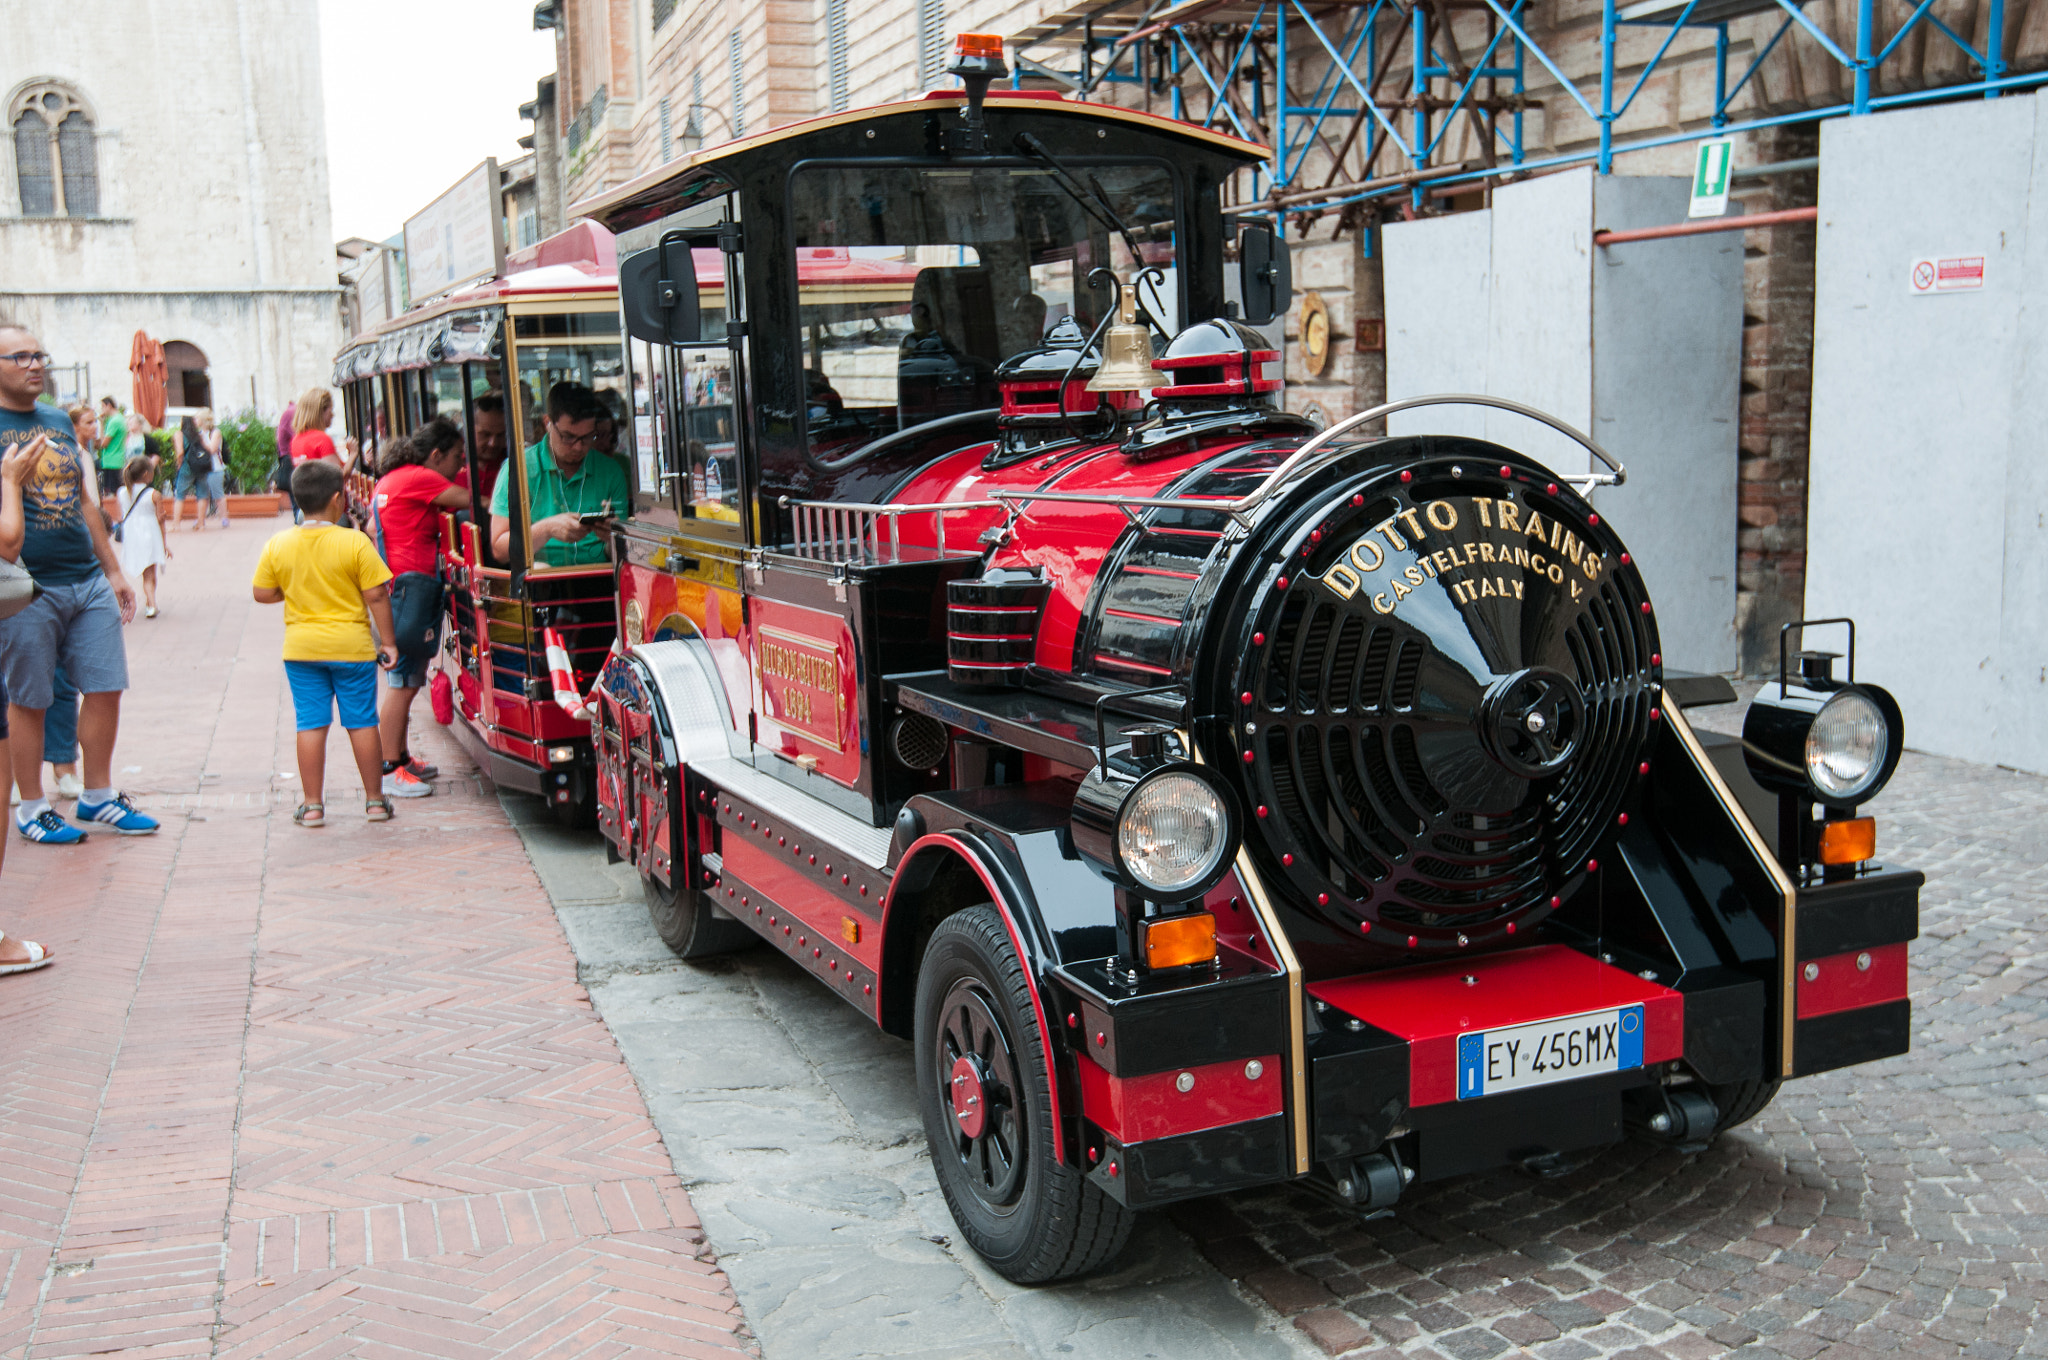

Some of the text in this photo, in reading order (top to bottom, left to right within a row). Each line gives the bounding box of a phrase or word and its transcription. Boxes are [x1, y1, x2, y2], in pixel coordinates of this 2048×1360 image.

[1322, 496, 1602, 600] DOTTO TRAINS
[1373, 542, 1564, 614] CASTELFRANCO
[1453, 577, 1525, 604] ITALY
[1488, 1022, 1618, 1081] EY 456MX
